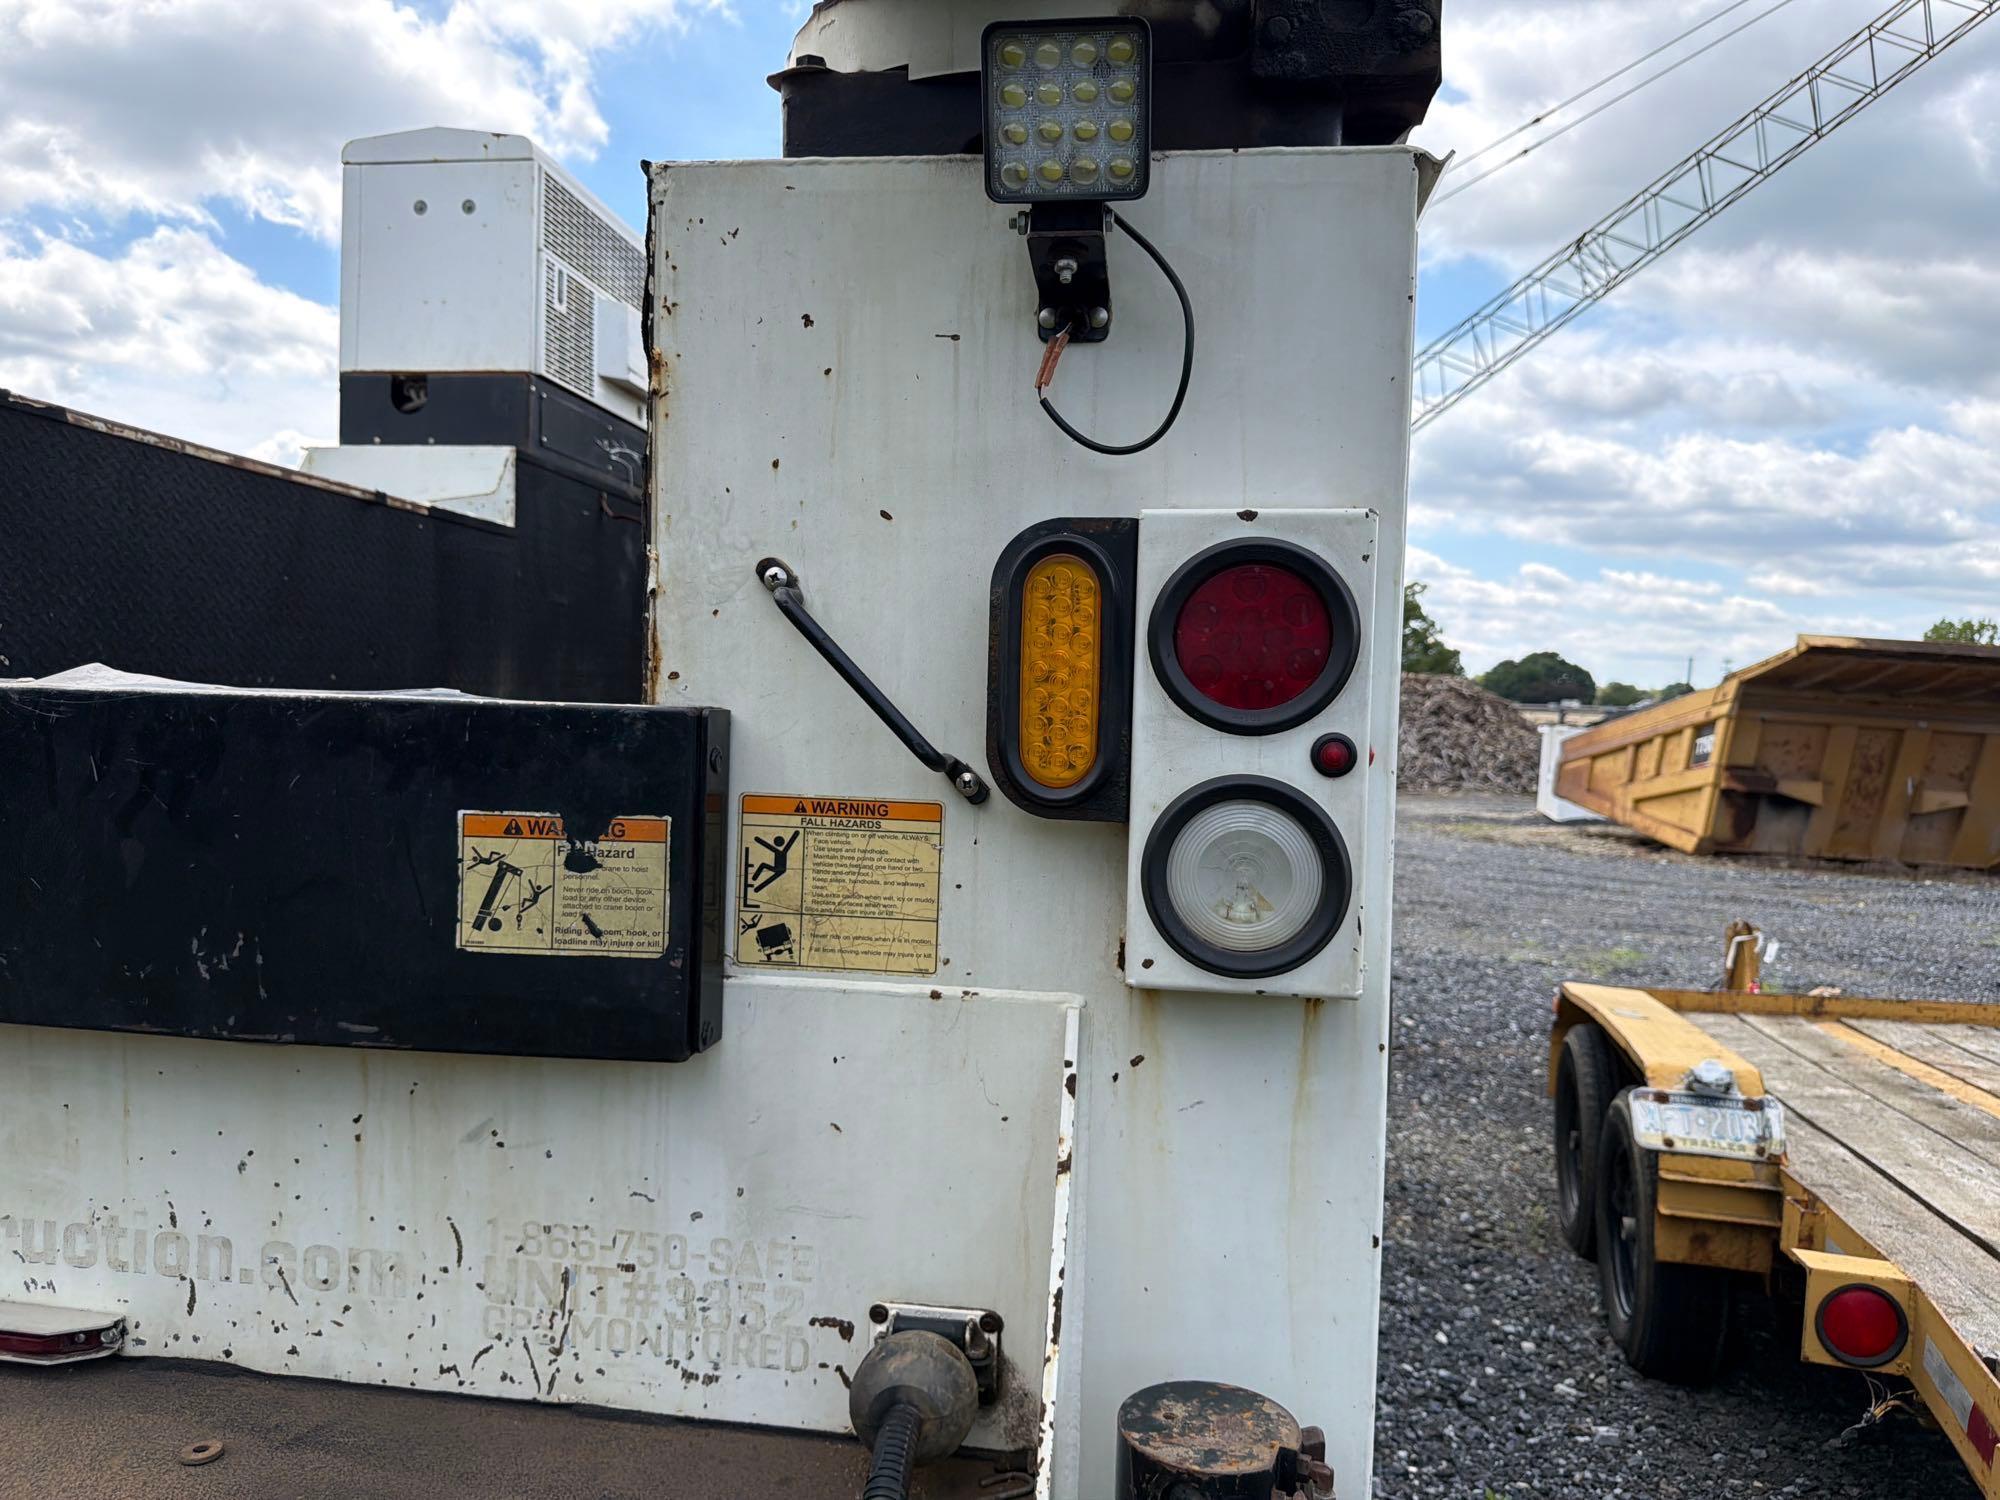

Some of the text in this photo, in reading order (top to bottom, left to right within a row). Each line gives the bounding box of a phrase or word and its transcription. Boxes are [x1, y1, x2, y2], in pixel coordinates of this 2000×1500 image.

[811, 800, 889, 817] WARNING
[800, 818, 882, 830] FALL HAZARDS
[632, 866, 649, 874] hoist
[563, 873, 599, 881] personnel.
[586, 886, 598, 894] ride
[623, 896, 647, 904] device
[624, 904, 645, 912] boom
[554, 926, 582, 936] Riding
[626, 929, 650, 938] hook,
[554, 937, 588, 946] loadline
[610, 939, 634, 948] injure
[647, 940, 662, 948] kill.
[837, 948, 860, 956] moving
[1681, 1139, 1746, 1152] TRAILER
[487, 1216, 814, 1283] 1-866-750-SAFE
